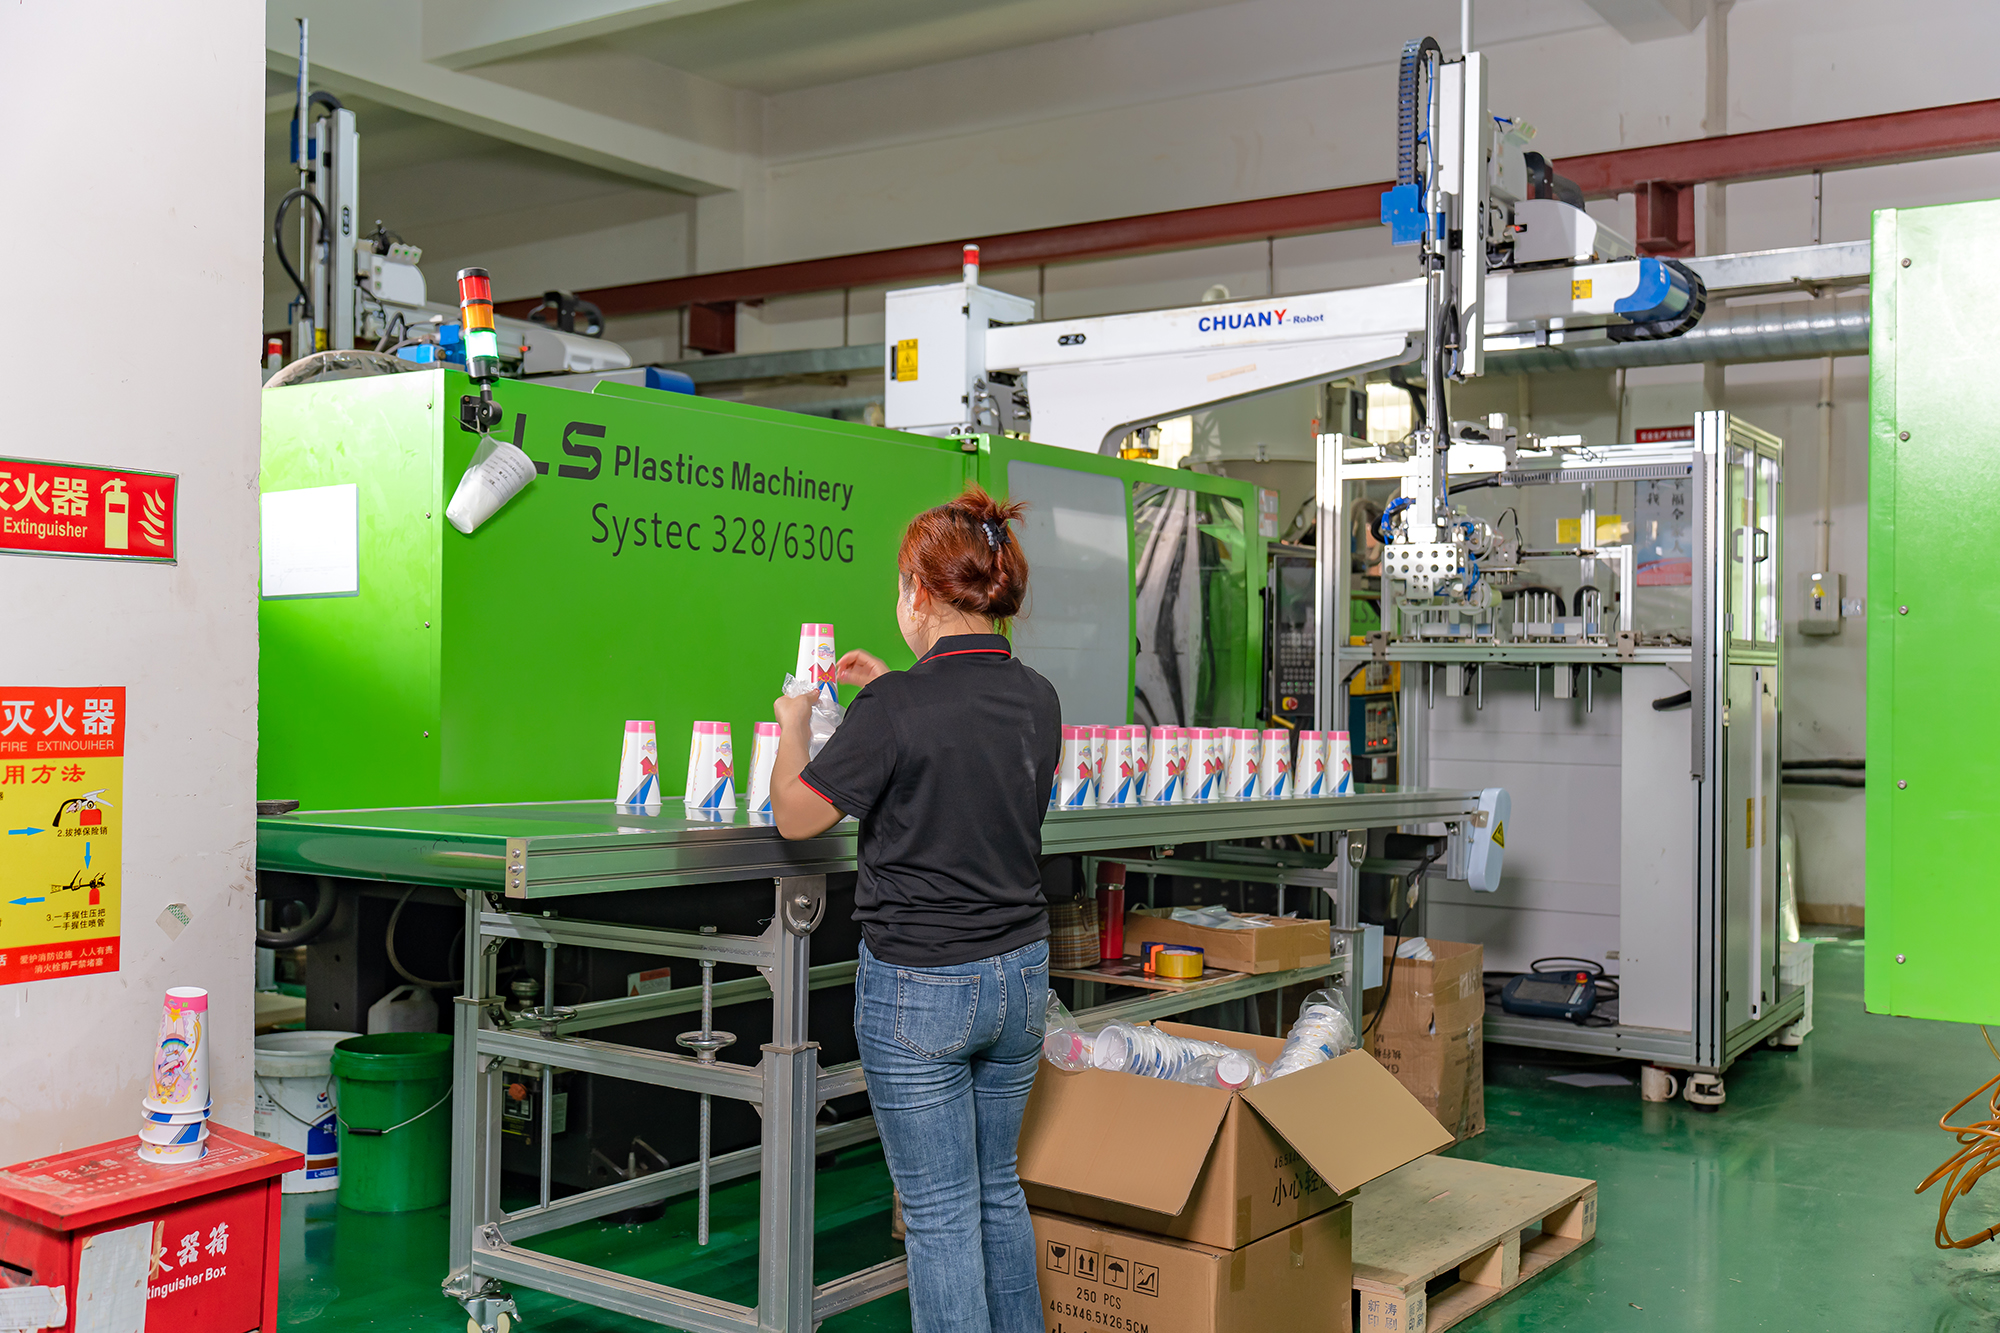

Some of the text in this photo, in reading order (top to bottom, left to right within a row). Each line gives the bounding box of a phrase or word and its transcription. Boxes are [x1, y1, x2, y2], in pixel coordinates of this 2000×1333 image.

[614, 445, 725, 489] Plastics
[731, 461, 854, 511] Machinery
[4, 516, 88, 539] Extinguisher
[591, 502, 854, 563] Systec 328/630G
[0, 699, 116, 736] 灭火器
[0, 740, 114, 752] FIRE EXTINOUIHER
[1272, 1166, 1328, 1207] 小心轻
[205, 1266, 227, 1282] Box
[1076, 1287, 1122, 1310] 250 PCS
[1049, 1300, 1149, 1333] 46.5X46.5X26.5CM
